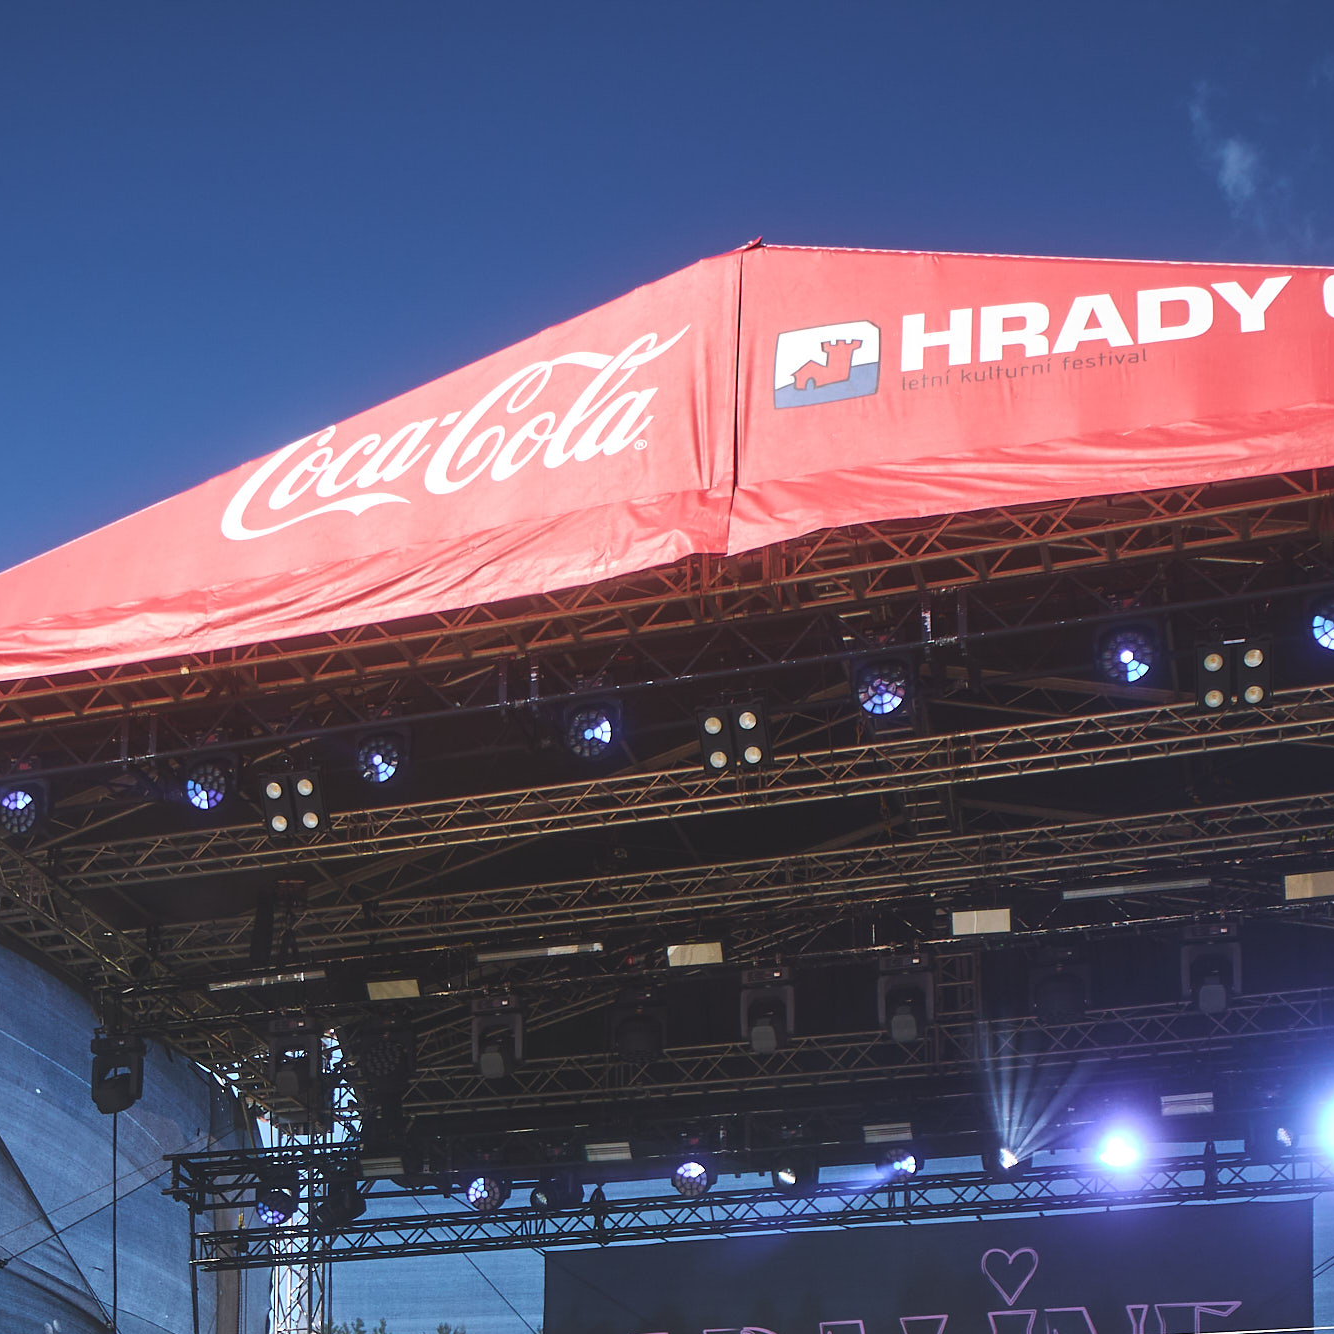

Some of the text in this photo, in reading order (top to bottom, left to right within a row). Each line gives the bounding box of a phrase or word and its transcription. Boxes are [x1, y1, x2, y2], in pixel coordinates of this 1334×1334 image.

[901, 275, 1292, 372] HRADY
[901, 347, 1148, 391] letní kulturní festival
[221, 324, 691, 541] Coca-Cola
